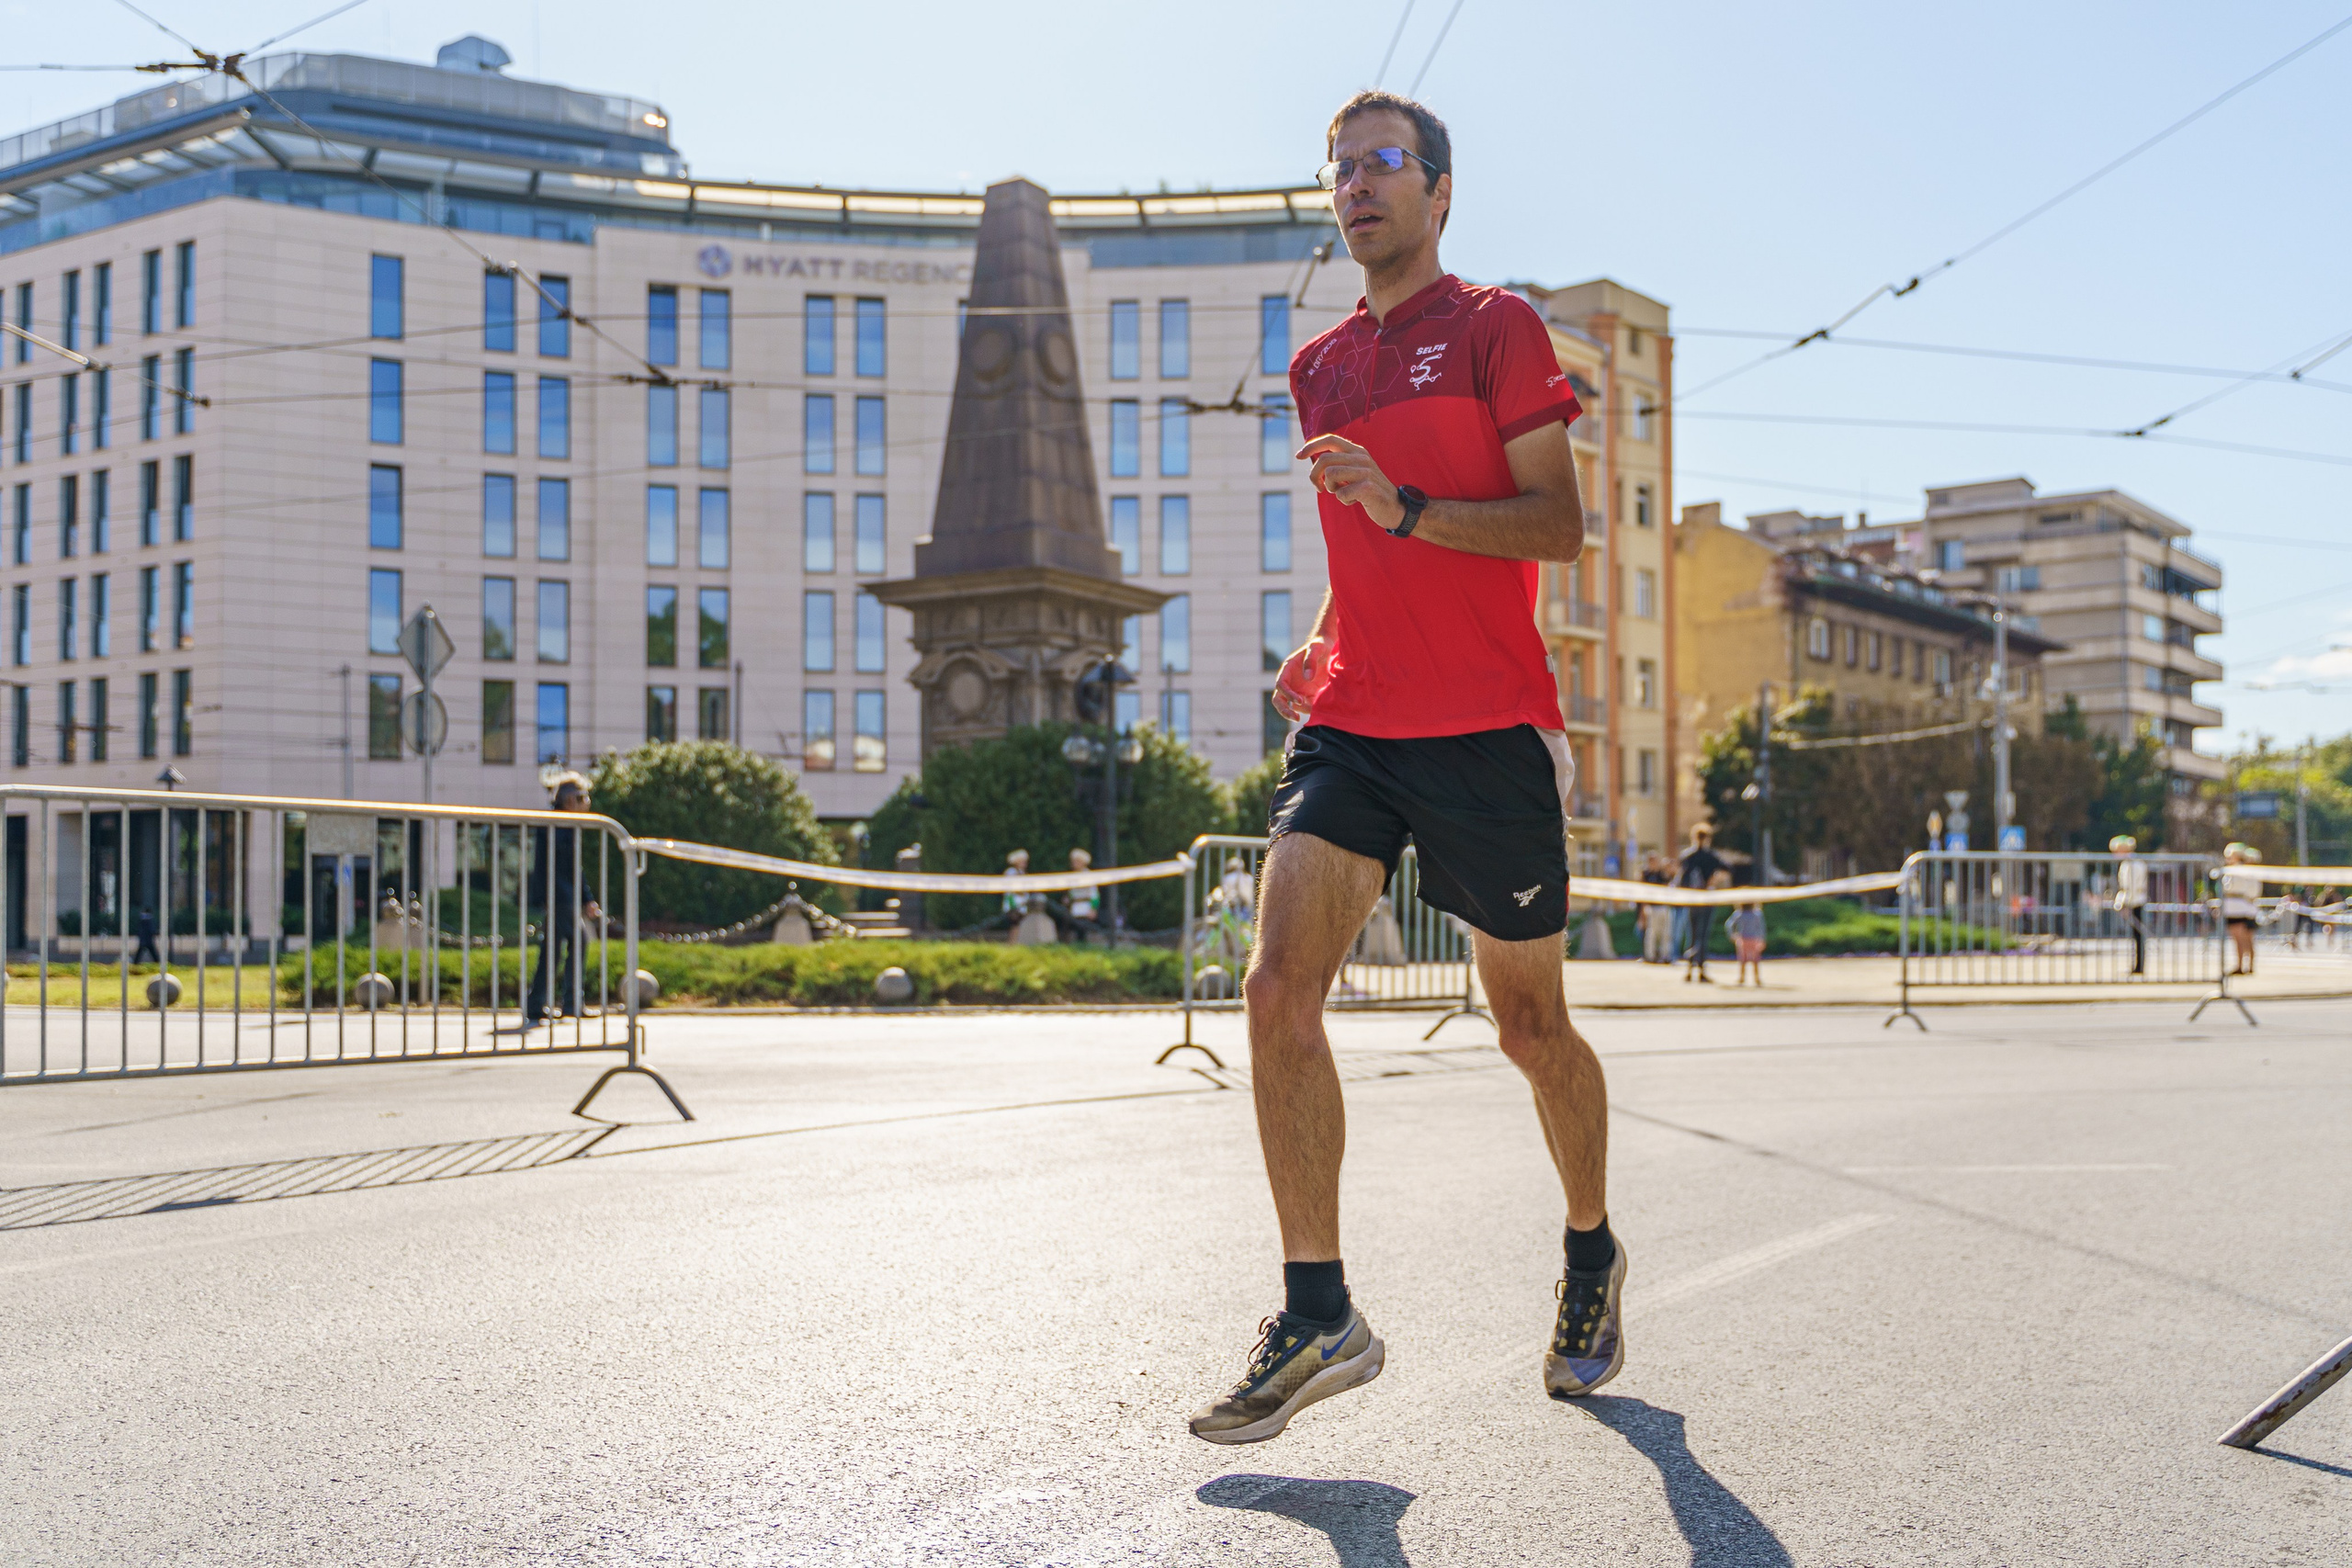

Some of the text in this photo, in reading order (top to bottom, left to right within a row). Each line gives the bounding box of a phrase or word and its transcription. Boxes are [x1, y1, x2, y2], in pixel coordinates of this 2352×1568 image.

[745, 255, 970, 284] HYATT REGENC
[1416, 343, 1448, 355] SELFIE
[1512, 884, 1542, 900] Reebok
